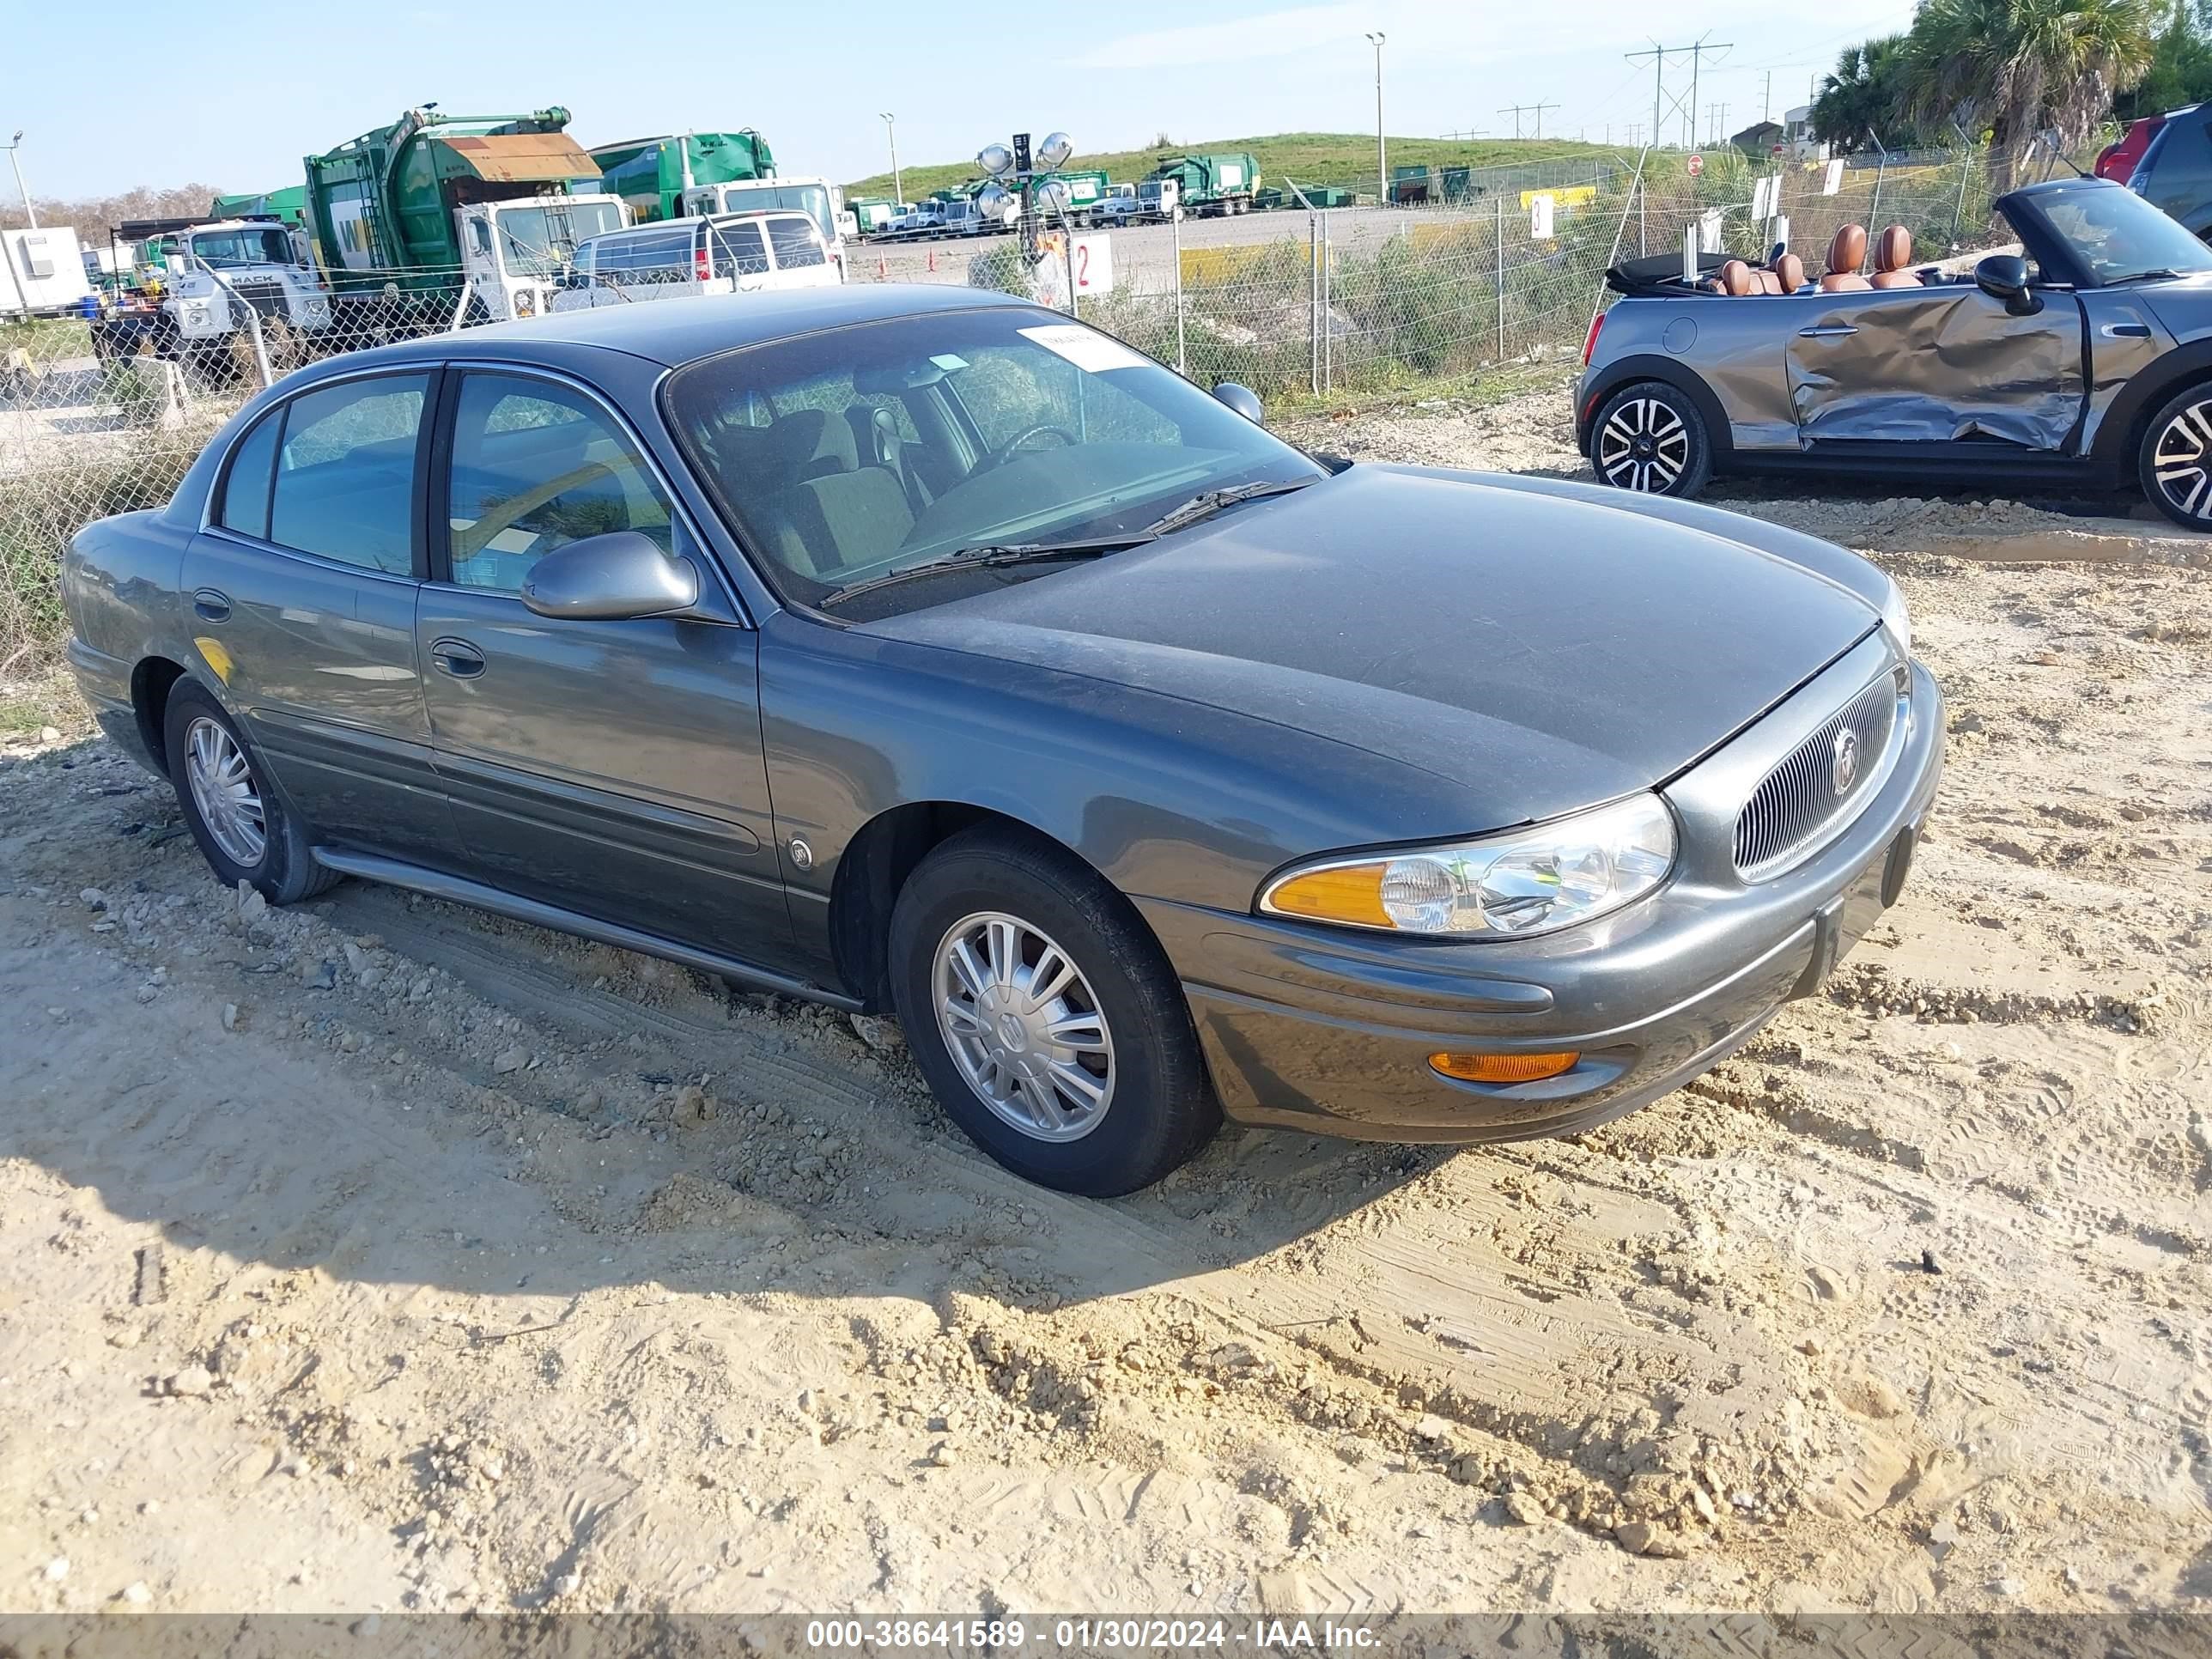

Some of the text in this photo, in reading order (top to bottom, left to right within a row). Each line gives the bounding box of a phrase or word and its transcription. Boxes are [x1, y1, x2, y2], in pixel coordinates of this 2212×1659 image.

[1534, 200, 1540, 232] 3
[231, 275, 274, 284] MACK
[1078, 245, 1089, 286] 2
